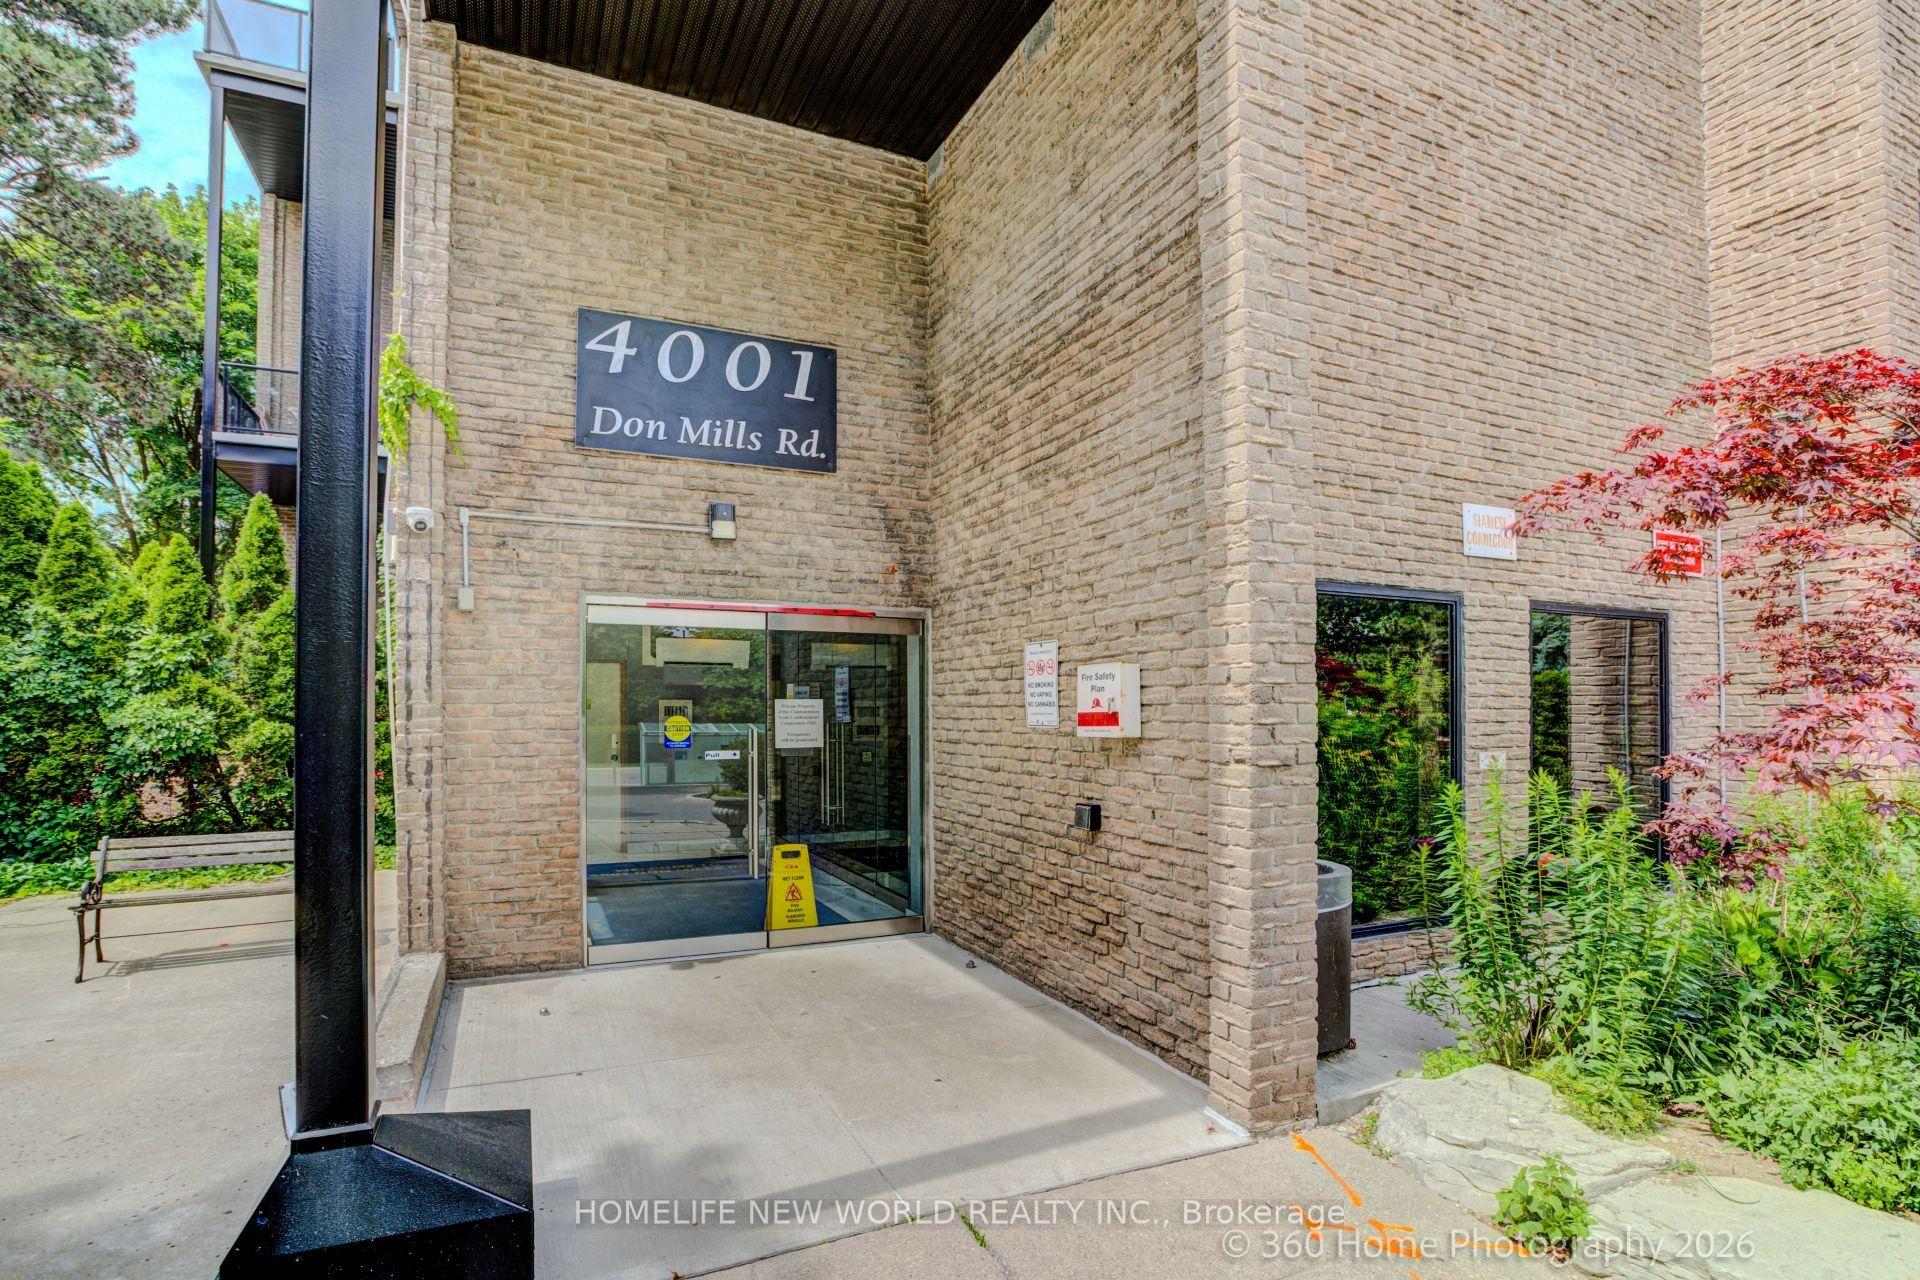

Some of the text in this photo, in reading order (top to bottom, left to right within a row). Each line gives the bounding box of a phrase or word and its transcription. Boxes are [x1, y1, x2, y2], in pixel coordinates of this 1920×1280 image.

[584, 320, 815, 402] 4001
[590, 405, 826, 459] Don Mills Rd.
[1081, 672, 1116, 682] Fire Safety
[1090, 685, 1105, 693] Plan
